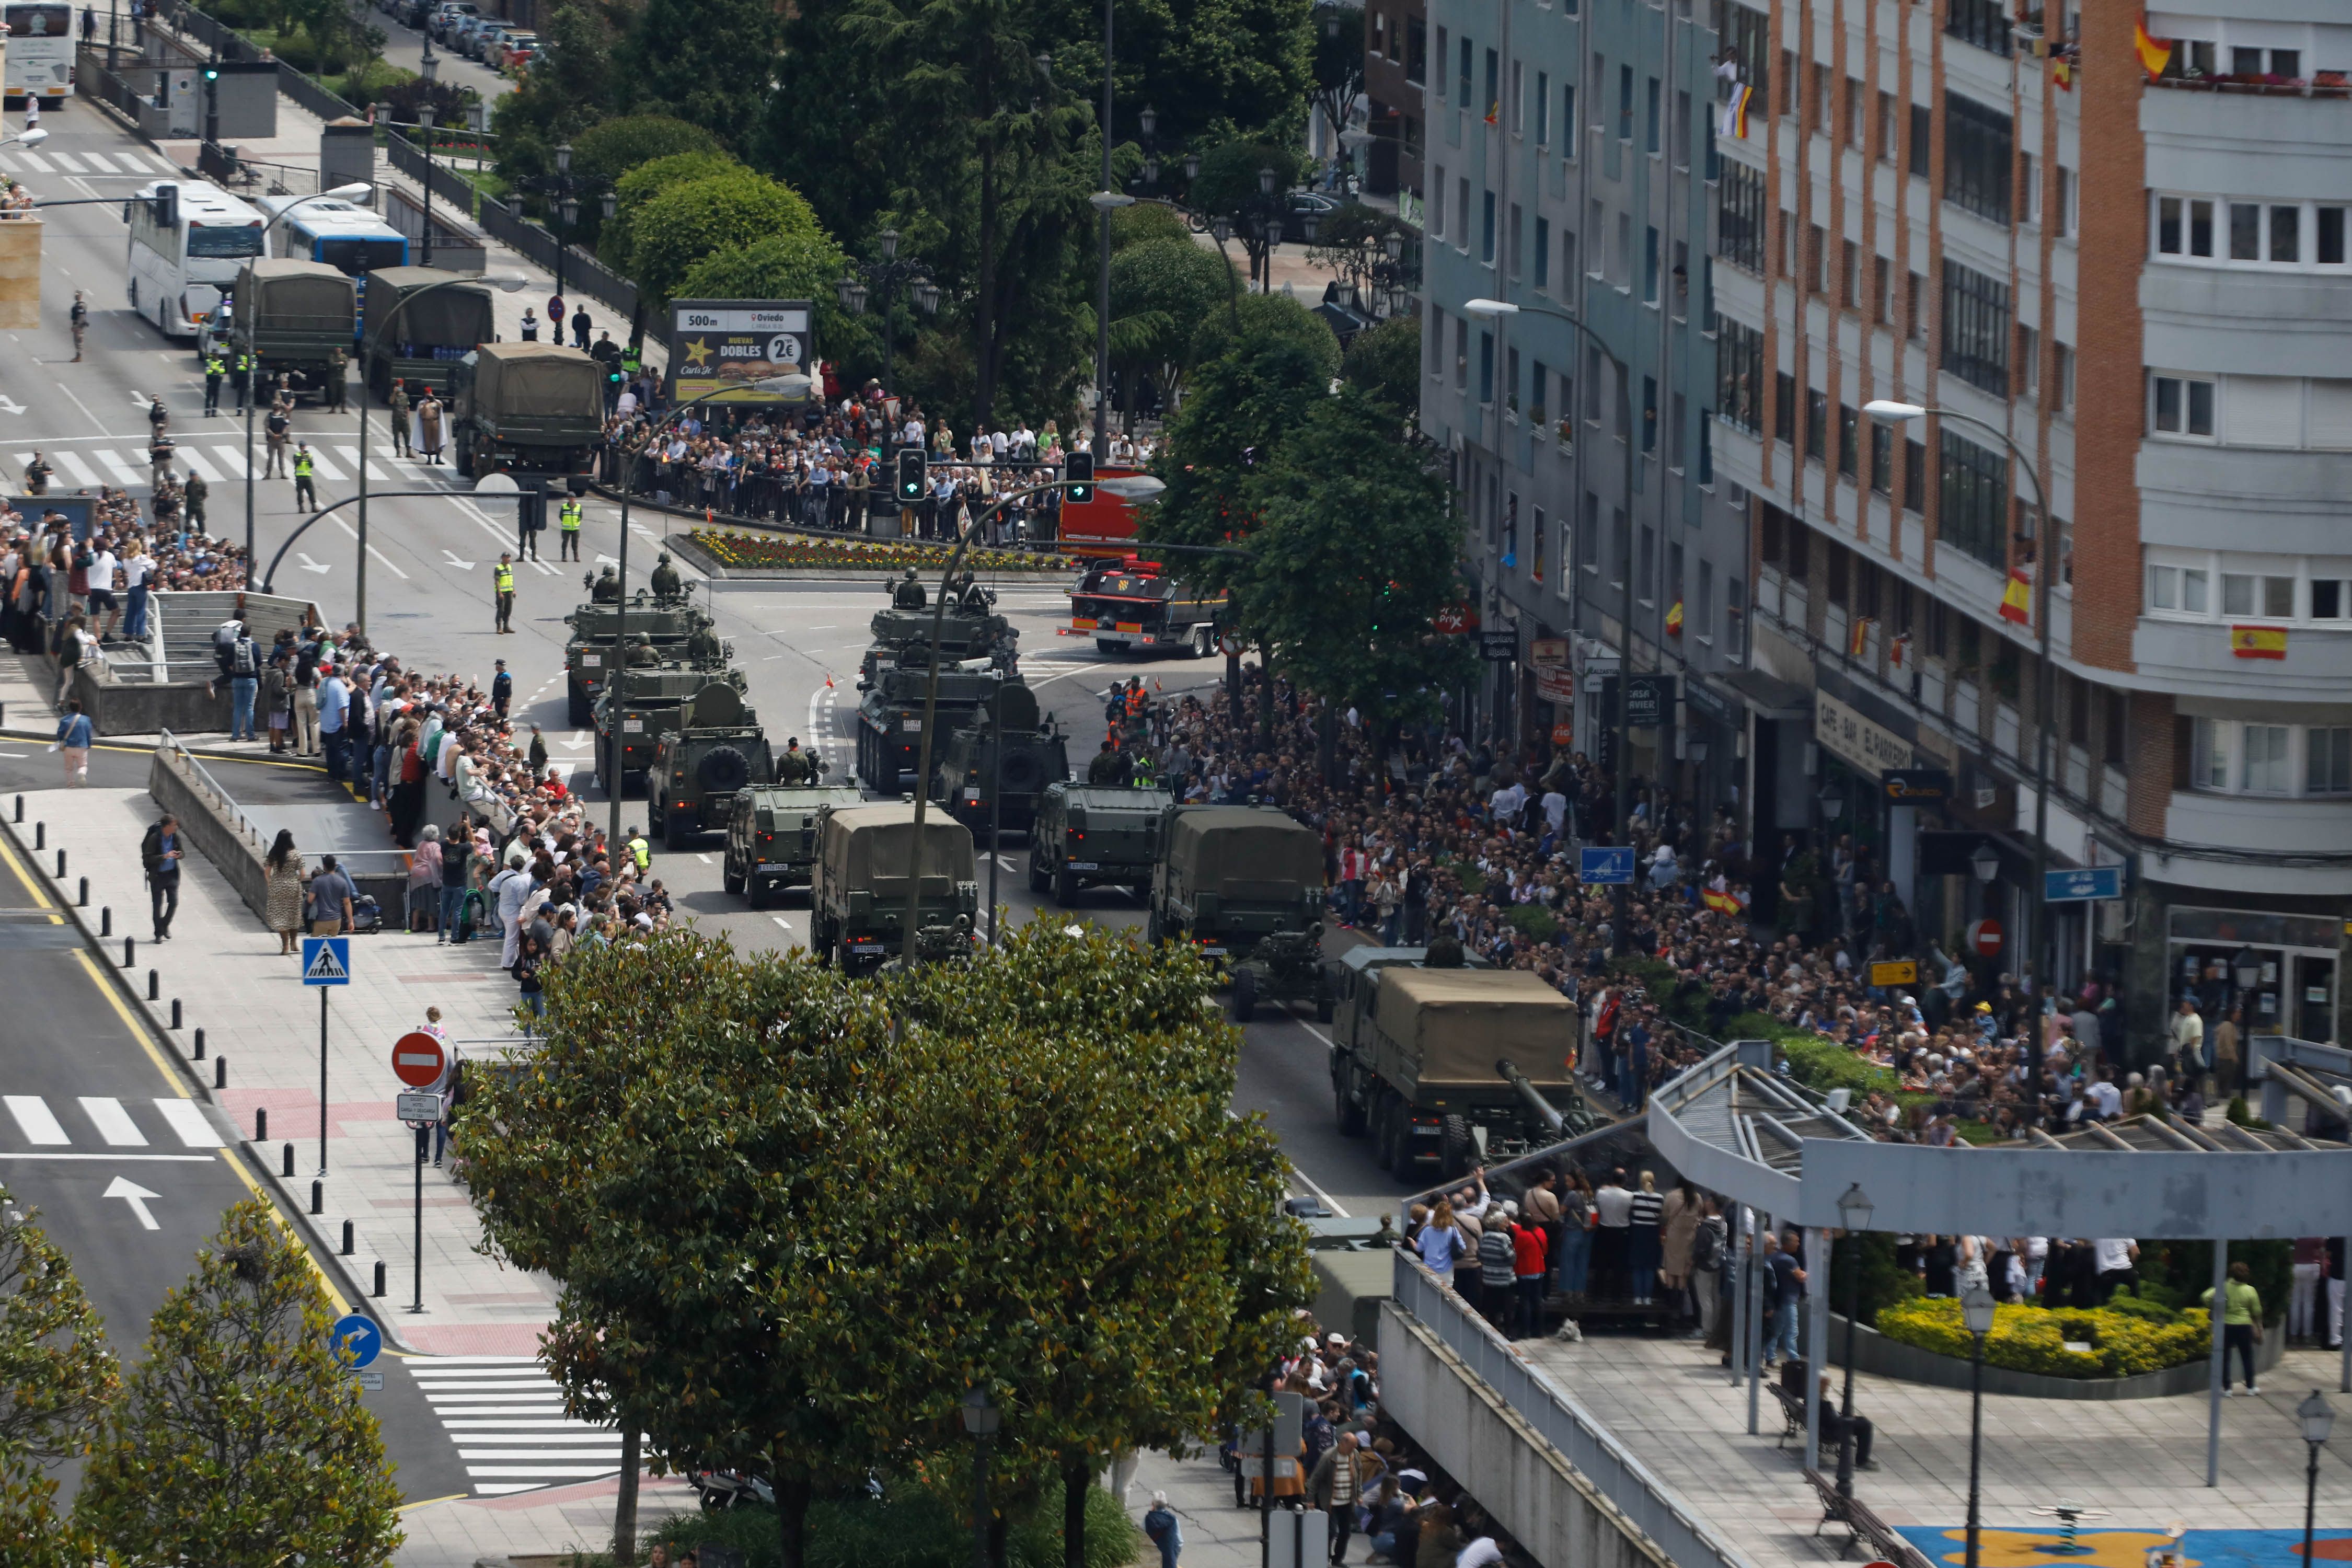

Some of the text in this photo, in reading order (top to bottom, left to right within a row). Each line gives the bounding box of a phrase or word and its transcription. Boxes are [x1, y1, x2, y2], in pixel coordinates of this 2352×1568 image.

[688, 316, 717, 326] 500m
[720, 345, 761, 357] DOBLES
[681, 366, 700, 374] Carl's
[1628, 700, 1655, 709] AVIER
